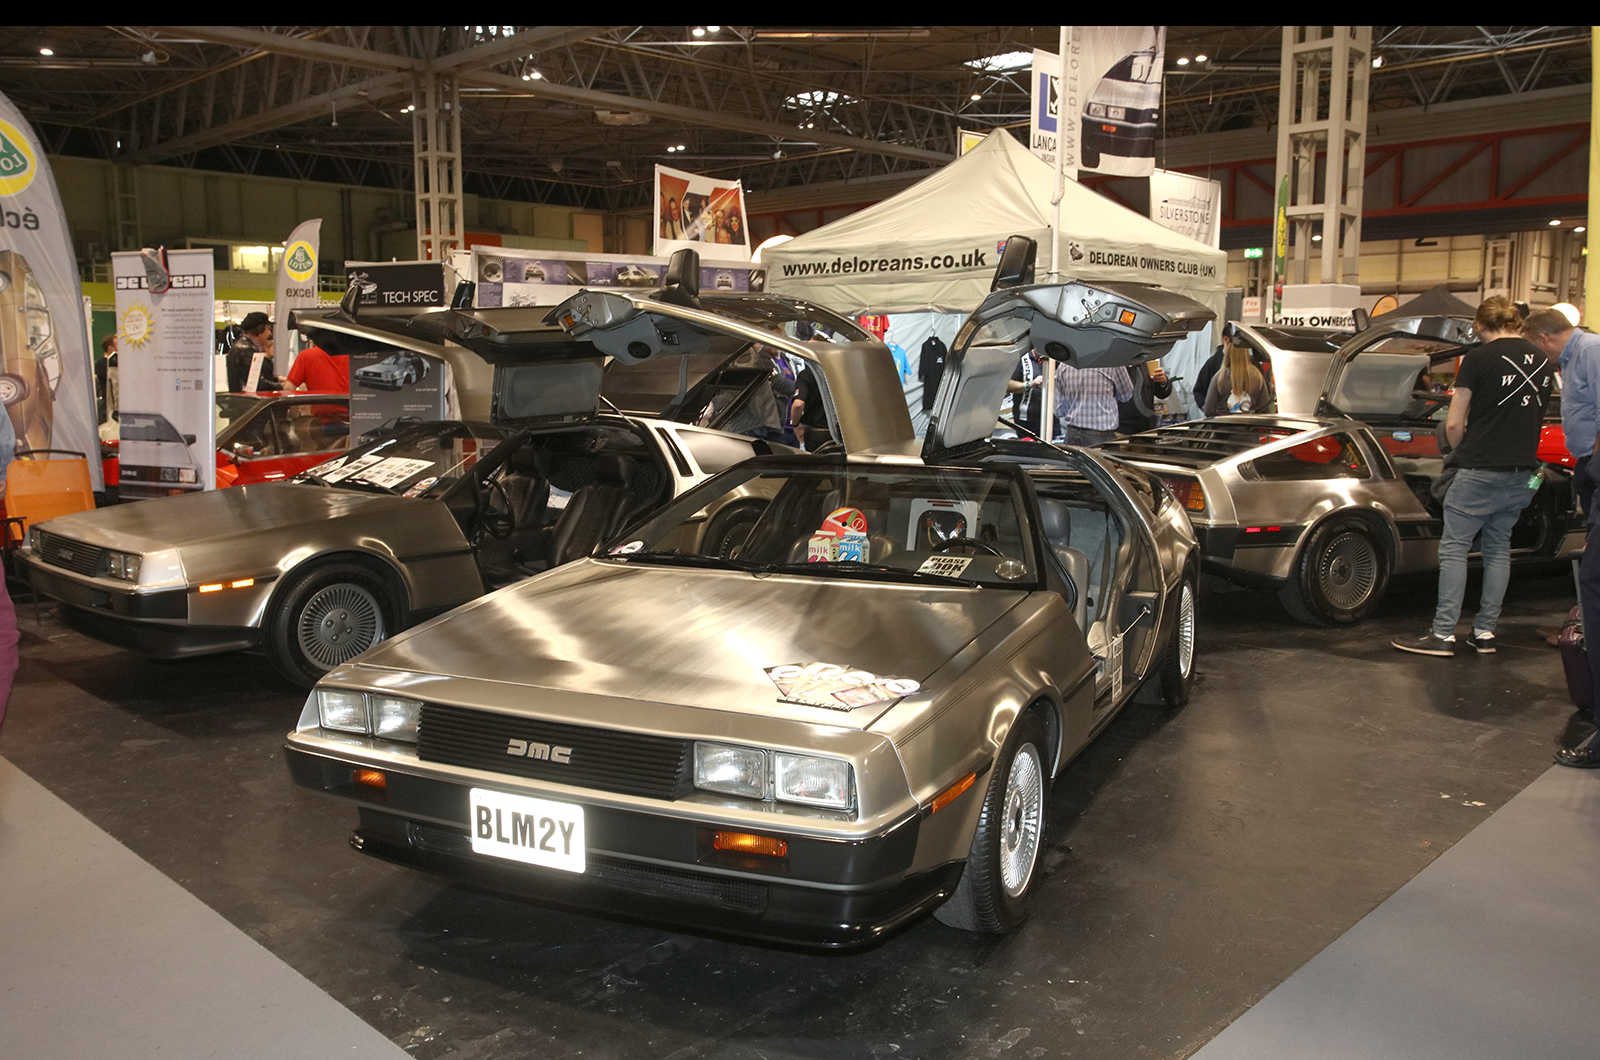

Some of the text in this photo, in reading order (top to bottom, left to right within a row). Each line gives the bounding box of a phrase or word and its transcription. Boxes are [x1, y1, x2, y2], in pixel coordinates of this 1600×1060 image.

[1160, 206, 1209, 225] SILVERSTONE
[289, 259, 312, 270] LOTUS
[783, 249, 986, 276] www.deloreans.co.uk
[1090, 251, 1216, 278] DELOREAN OWNERS CLUB (UK)
[286, 286, 314, 298] excel
[383, 291, 410, 303] TECH
[413, 290, 438, 302] SPEC
[1523, 354, 1535, 365] N
[1501, 374, 1517, 387] W
[1541, 376, 1550, 387] E
[1520, 395, 1531, 406] S
[808, 546, 828, 554] milk
[840, 543, 860, 552] milk
[922, 562, 965, 571] OOK
[507, 738, 573, 764] DMC
[476, 805, 575, 856] BLM2Y
